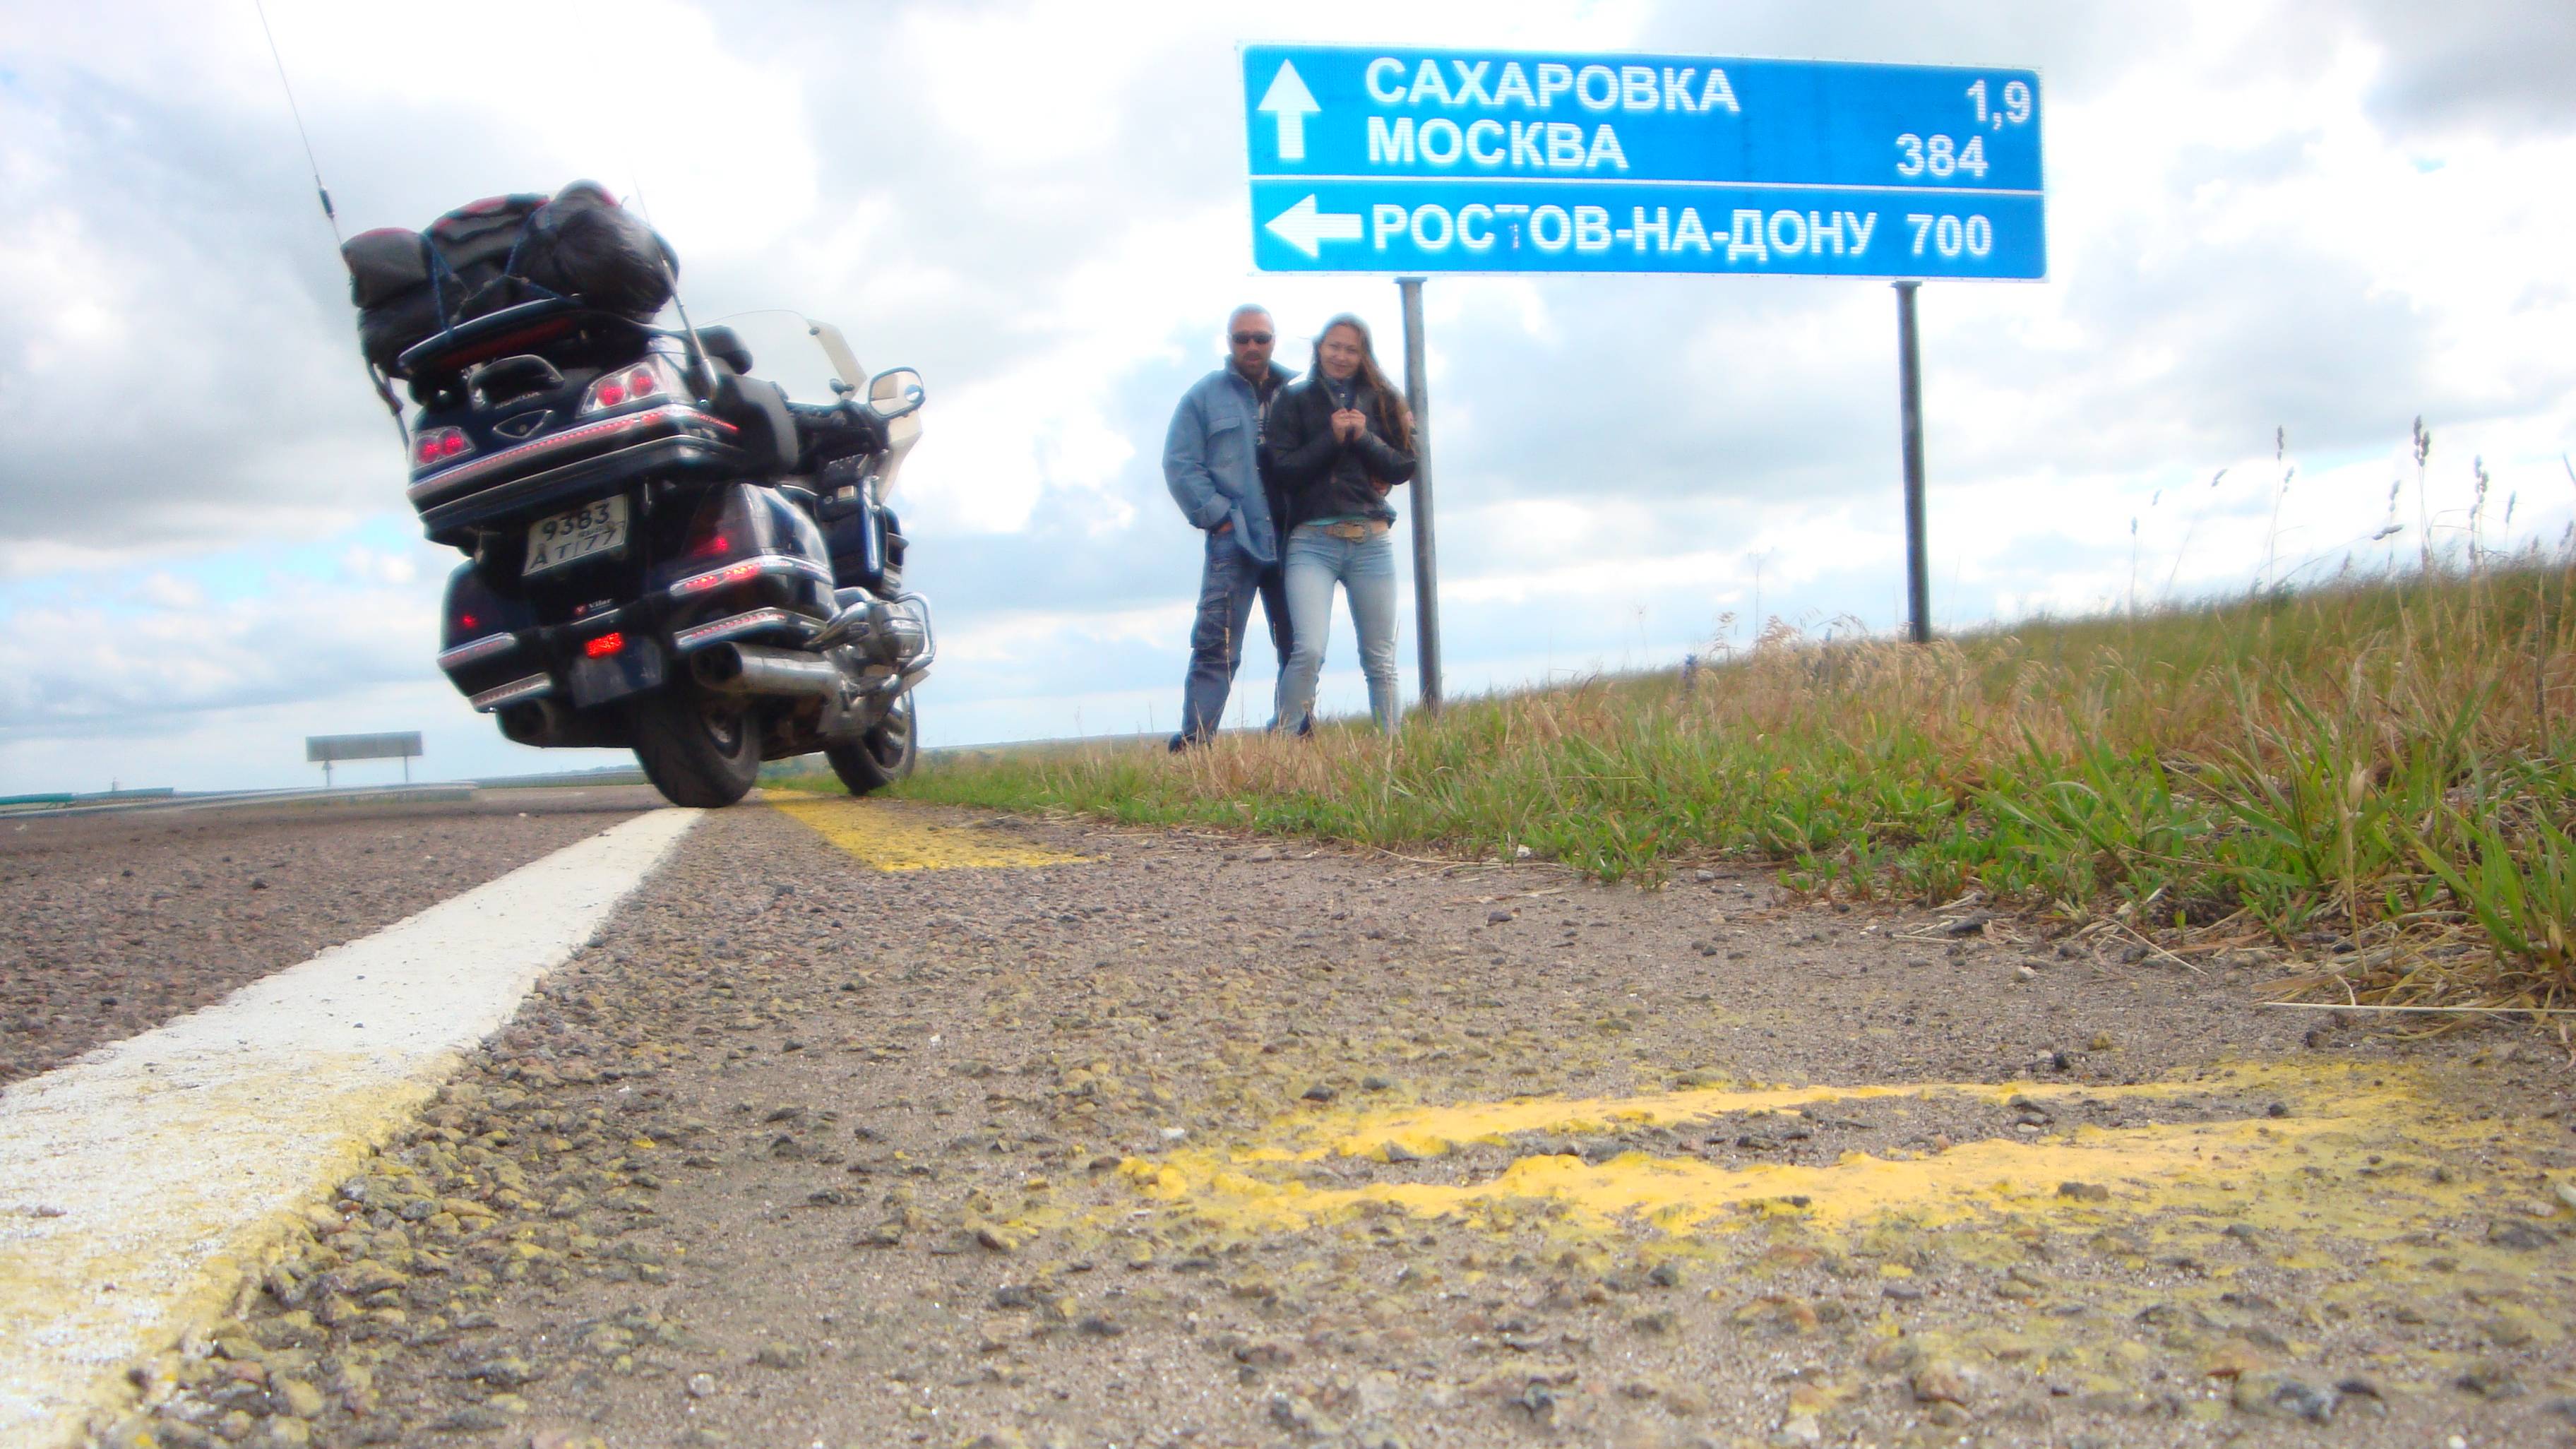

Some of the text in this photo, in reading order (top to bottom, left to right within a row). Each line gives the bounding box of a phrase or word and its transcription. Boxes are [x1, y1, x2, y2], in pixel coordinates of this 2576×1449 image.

[1366, 56, 2032, 131] САХАРОВКА 1,9
[1367, 115, 1989, 177] МОСКВА 384
[1906, 213, 1992, 256] 700
[542, 502, 609, 542] 9383
